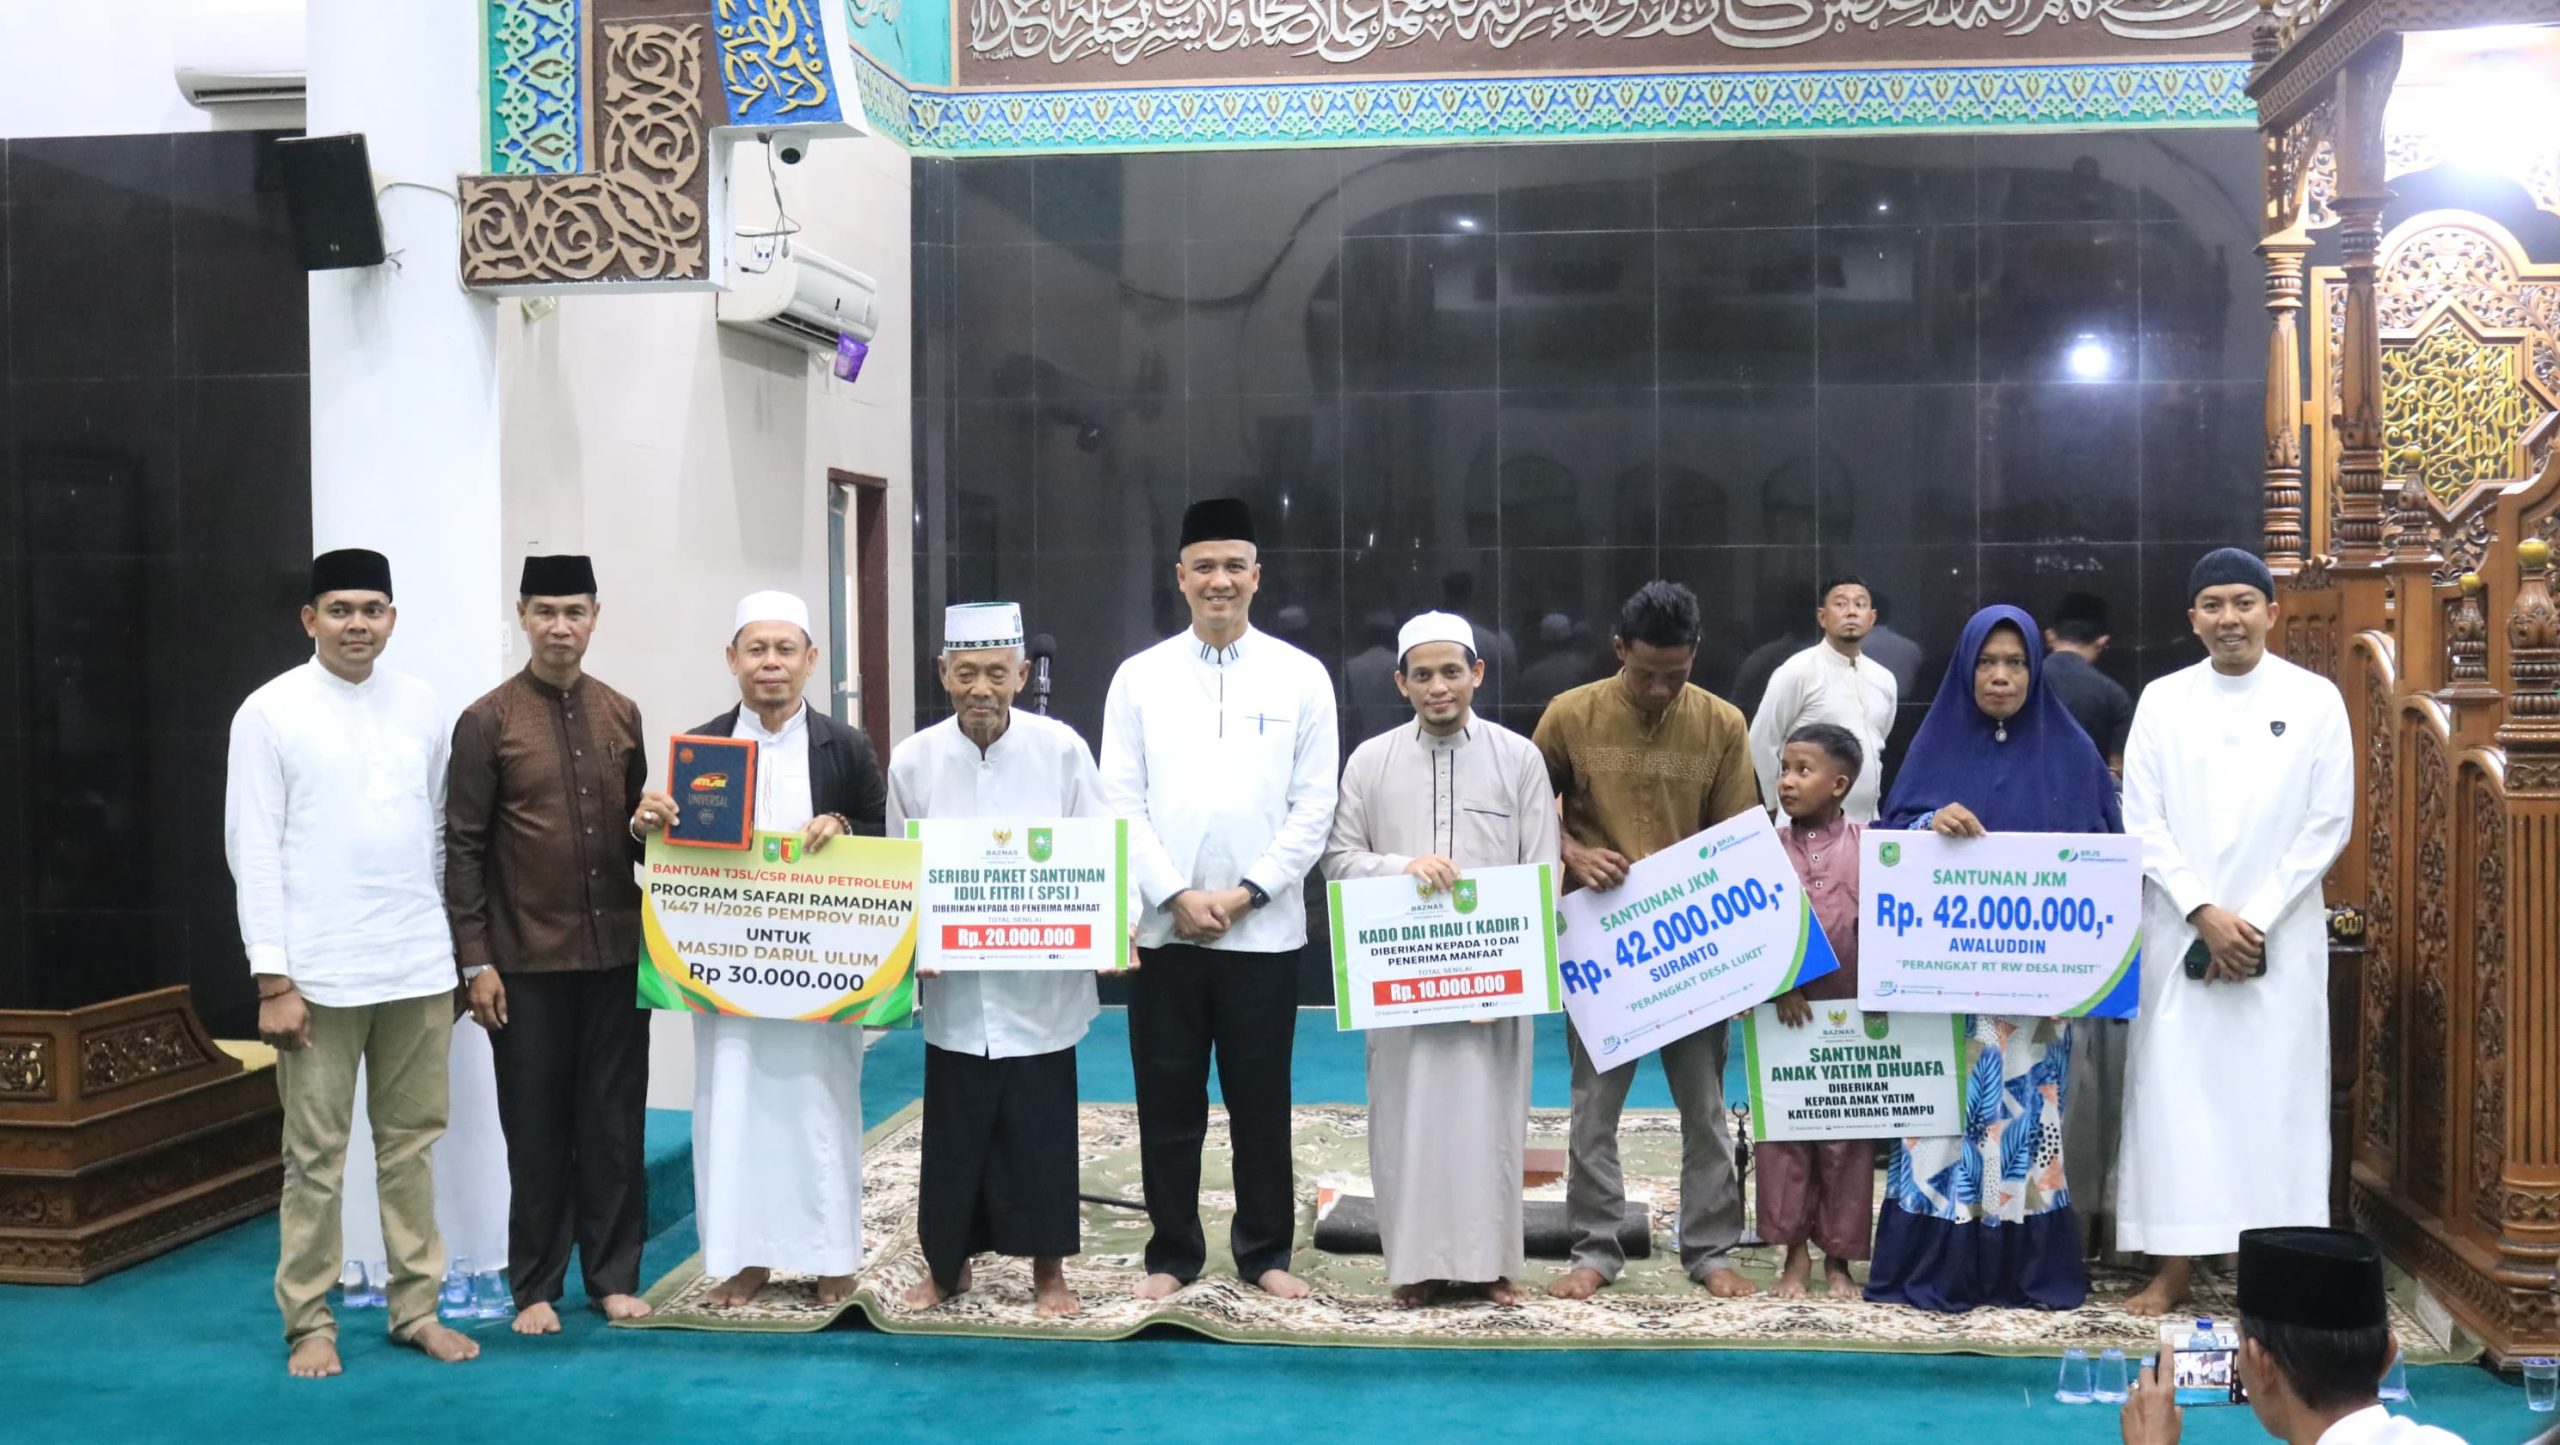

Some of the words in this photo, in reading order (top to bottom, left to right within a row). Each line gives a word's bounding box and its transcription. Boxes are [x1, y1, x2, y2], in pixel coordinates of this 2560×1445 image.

[652, 864, 720, 878] BANTUAN
[724, 868, 786, 882] TJSL/CSR
[791, 872, 824, 884] RIAU
[828, 875, 913, 890] PETROLEUM
[929, 869, 980, 884] SERIBU
[984, 869, 1026, 883] PAKET
[1030, 868, 1105, 883] SANTUNAN
[1933, 869, 2026, 886] SANTUNAN
[2032, 871, 2066, 887] JKM
[651, 883, 737, 900] PROGRAM
[743, 890, 804, 904] SAFARI
[810, 894, 912, 912] RAMADHAN
[954, 886, 986, 900] IDUL
[990, 886, 1024, 900] FITRI
[1601, 884, 1685, 932] SANTUNAN
[1688, 868, 1719, 894] JKM
[662, 900, 698, 912] 1447
[704, 902, 762, 918] H/2026
[768, 907, 853, 924] PEMPROV
[858, 914, 900, 928] RIAU
[932, 904, 975, 912] DIBERIKAN
[978, 904, 1008, 912] KEPADA
[1010, 904, 1020, 912] 40
[1022, 904, 1062, 912] PENERIMA
[1064, 904, 1100, 912] MANFAAT
[1878, 893, 1923, 936] Rp.
[1934, 894, 2114, 940] 42.000.000,-
[746, 928, 811, 944] UNTUK
[958, 928, 982, 948] Rp.
[986, 928, 1075, 946] 20.000.000
[1359, 928, 1398, 944] KADO
[1402, 925, 1426, 940] DAI
[1430, 922, 1464, 939] RIAU
[1560, 960, 1612, 995] Rp.
[1616, 878, 1784, 968] 42.000.000,-
[678, 940, 748, 958] MASJID
[754, 946, 818, 963] DARUL
[824, 950, 878, 967] ULUM
[1371, 943, 1432, 956] DIBERIKAN
[1436, 939, 1480, 950] KEPADA
[1484, 938, 1497, 947] 10
[1500, 936, 1519, 946] DAI
[1950, 938, 2046, 954] AWALUDDIN
[1388, 954, 1448, 966] PENERIMA
[1450, 949, 1503, 960] MANFAAT
[1650, 942, 1718, 982] SURANTO
[690, 962, 720, 985] Rp
[728, 965, 864, 992] 30.000.000
[1418, 968, 1440, 976] TOTAL
[1700, 964, 1730, 982] DESA
[1982, 961, 1996, 972] RT
[2001, 962, 2022, 972] RW
[2026, 963, 2058, 974] DESA
[1391, 984, 1416, 1002] Rp.
[1418, 975, 1506, 998] 10.000.000
[1810, 1045, 1902, 1062] SANTUNAN
[1772, 1066, 1817, 1082] ANAK
[1822, 1063, 1872, 1079] YATIM
[1877, 1061, 1944, 1078] DHUAFA
[1828, 1082, 1888, 1094] DIBERIKAN
[1805, 1096, 1847, 1106] KEPADA
[1850, 1094, 1879, 1105] ANAK
[1882, 1094, 1914, 1104] YATIM
[1788, 1108, 1840, 1120] KATEGORI
[1844, 1106, 1889, 1118] KURANG
[1892, 1105, 1934, 1116] MAMPU
